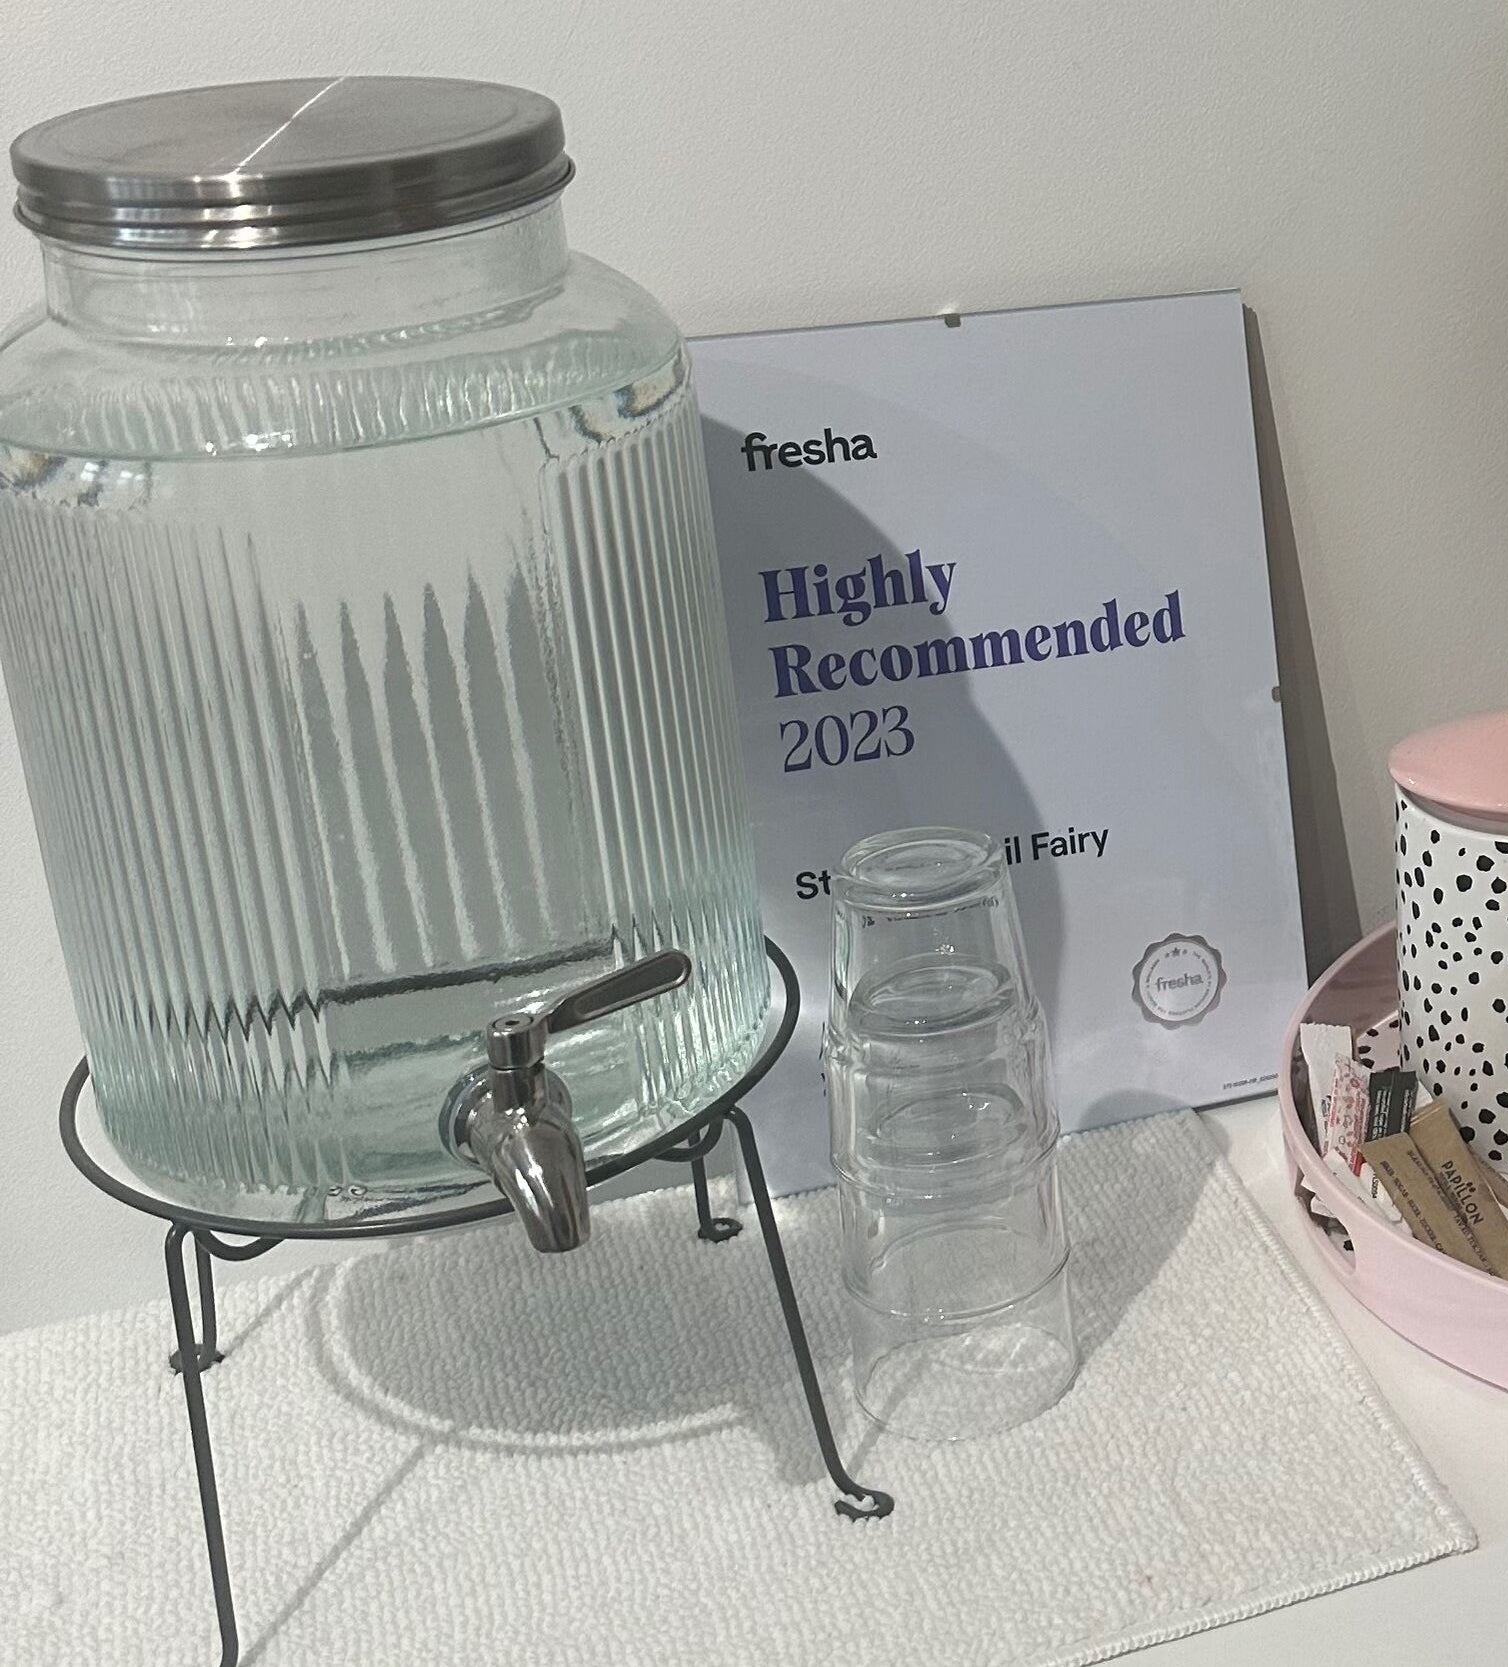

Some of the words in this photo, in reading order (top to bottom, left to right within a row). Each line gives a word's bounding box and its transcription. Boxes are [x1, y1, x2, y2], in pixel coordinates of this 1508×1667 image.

[741, 428, 877, 471] fresha
[758, 549, 957, 627] Highly
[768, 589, 1186, 698] Recommended
[779, 705, 915, 773] 2023
[1004, 836, 1022, 865] il
[1031, 827, 1109, 861] Fairy
[1155, 973, 1204, 992] fresha
[1441, 1160, 1484, 1225] PAPILLON
